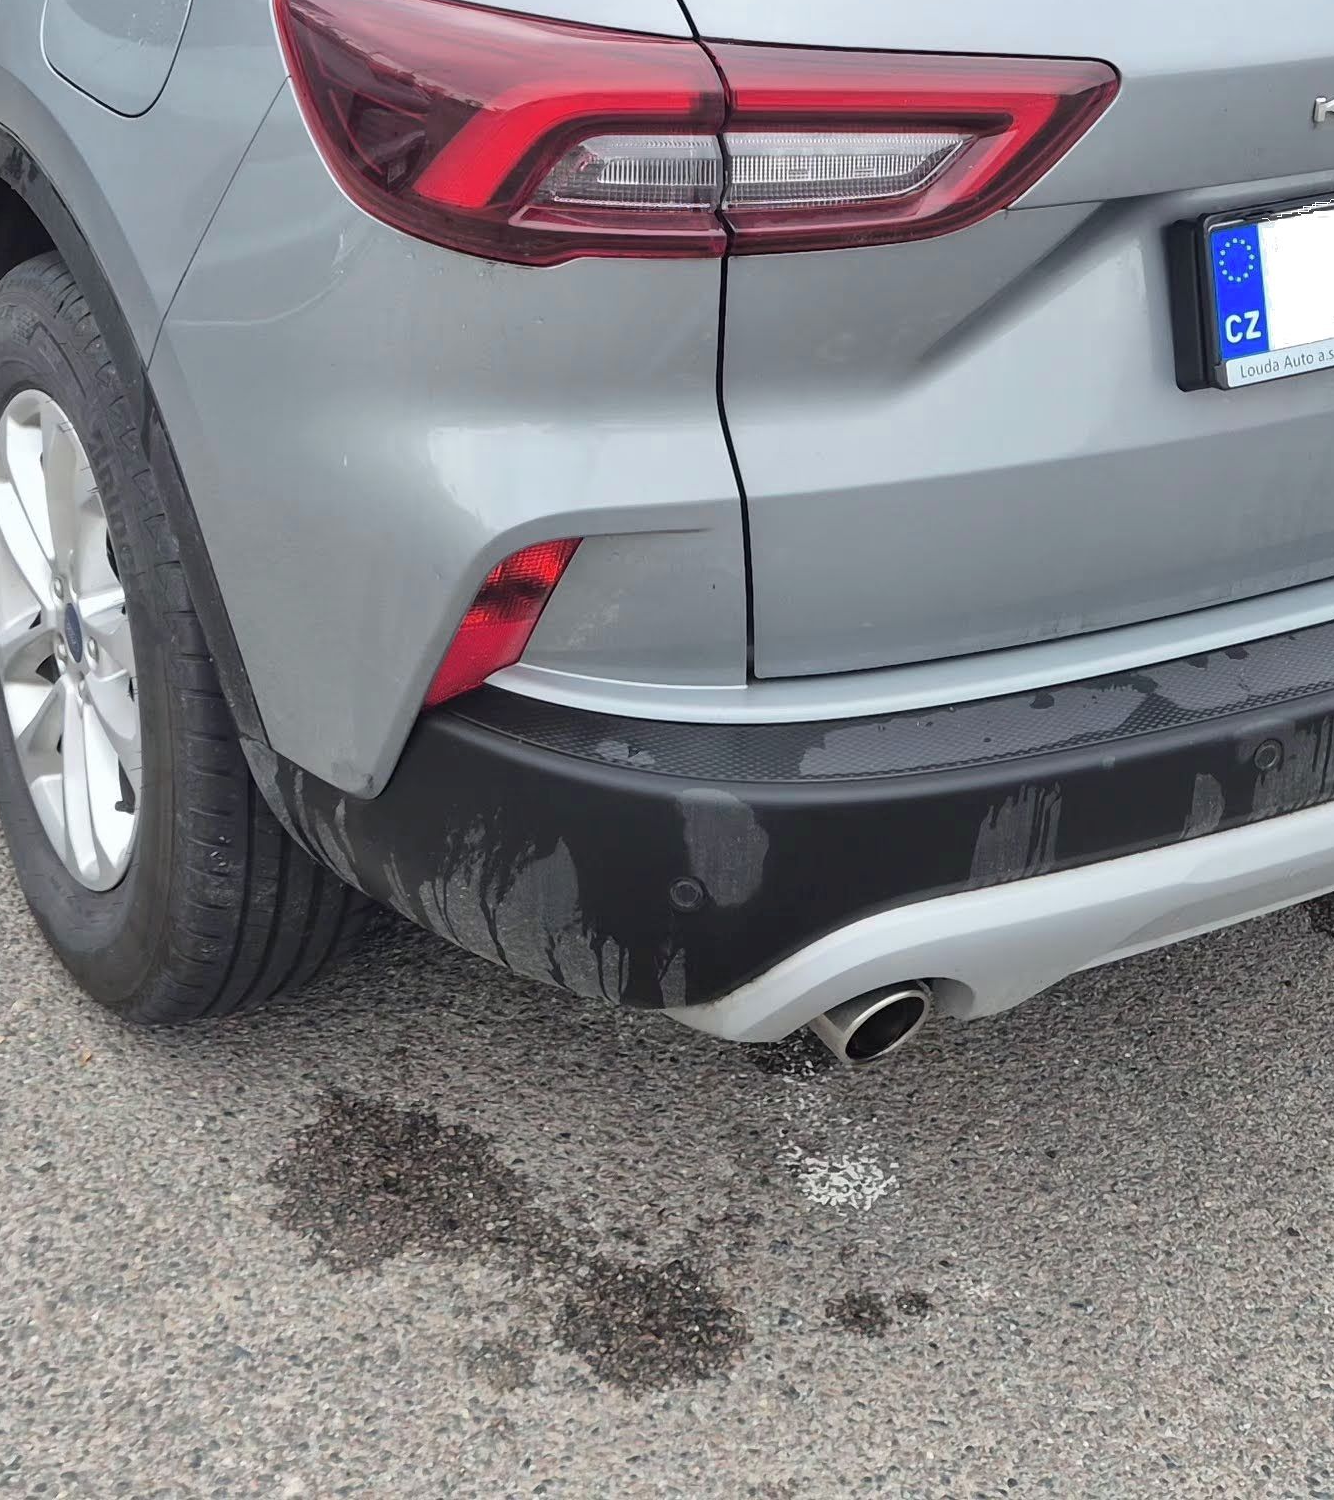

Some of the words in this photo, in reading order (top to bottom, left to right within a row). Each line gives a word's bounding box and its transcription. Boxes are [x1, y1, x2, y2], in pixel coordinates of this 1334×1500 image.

[1224, 309, 1262, 344] CZ
[1240, 358, 1280, 379] Louda
[1284, 351, 1315, 369] Auto
